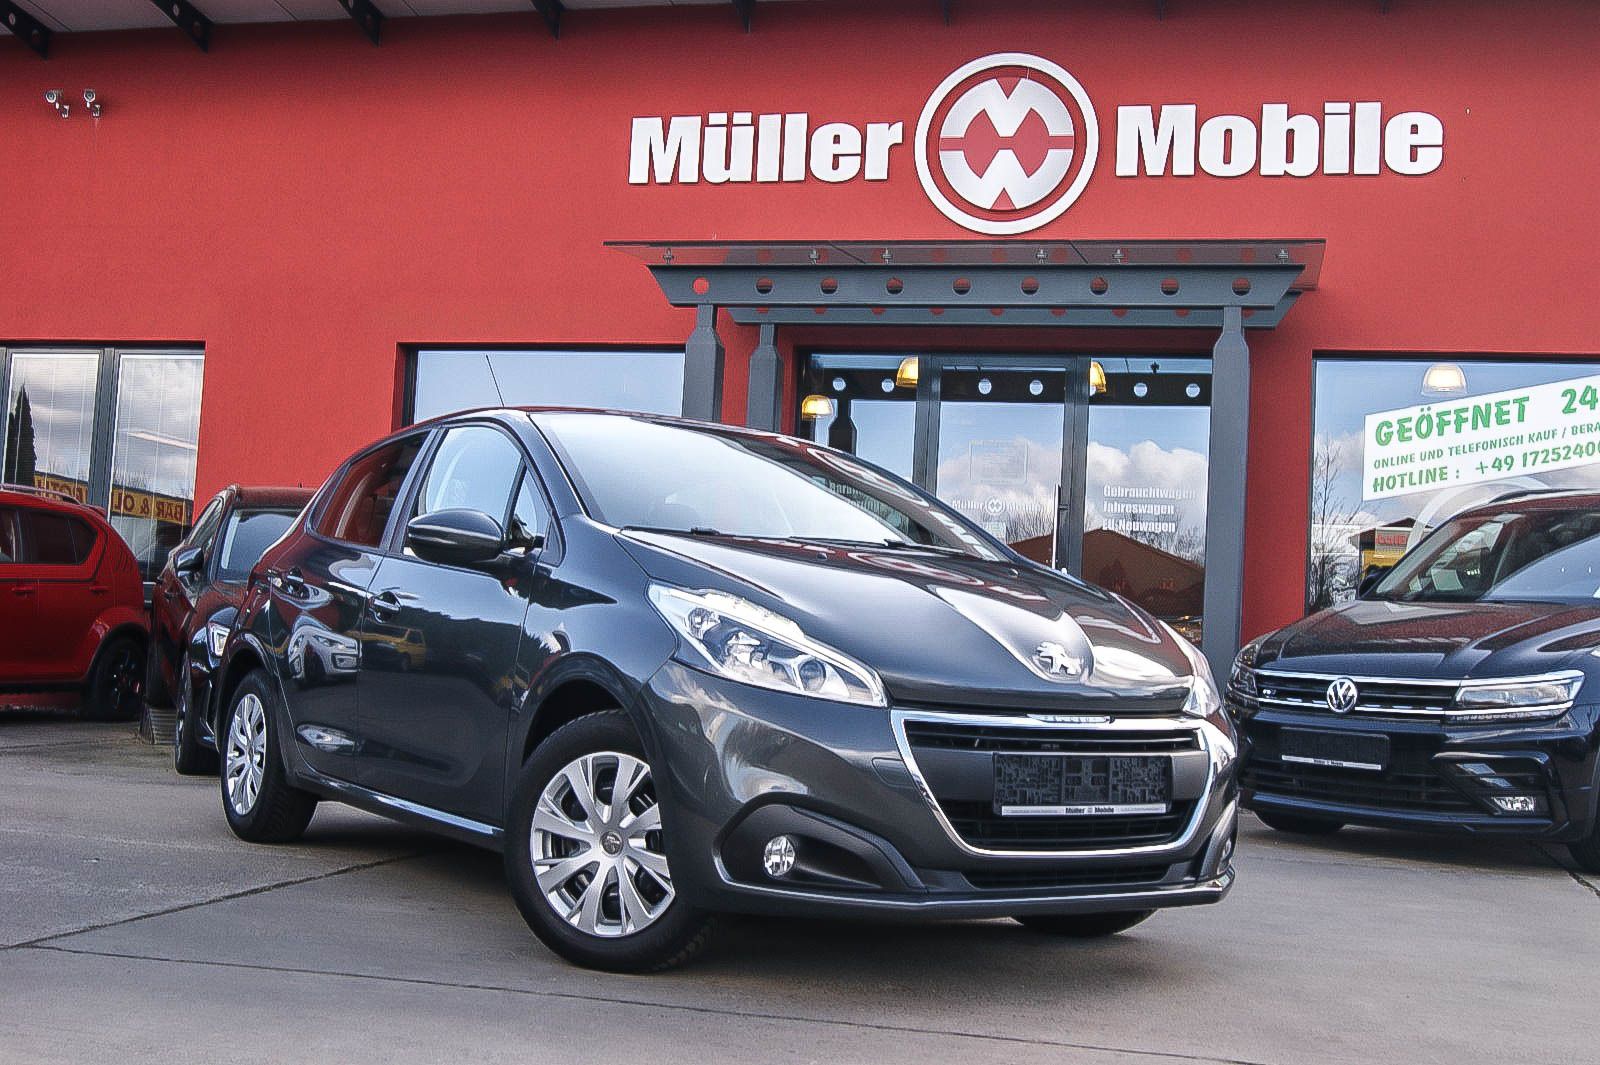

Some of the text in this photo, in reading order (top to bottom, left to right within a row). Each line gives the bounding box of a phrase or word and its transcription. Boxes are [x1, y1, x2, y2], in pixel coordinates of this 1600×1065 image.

[628, 111, 903, 184] Müller
[1115, 101, 1444, 177] Mobile
[1375, 385, 1599, 446] GEÖFFNET 24
[1372, 466, 1448, 492] HOTLINE
[1475, 454, 1515, 475] +49
[1522, 440, 1600, 468] 1725240
[1373, 453, 1416, 470] ONLINE
[1420, 449, 1444, 461] UND
[1448, 435, 1524, 457] TELEFONISCH
[1528, 428, 1558, 444] KAUF
